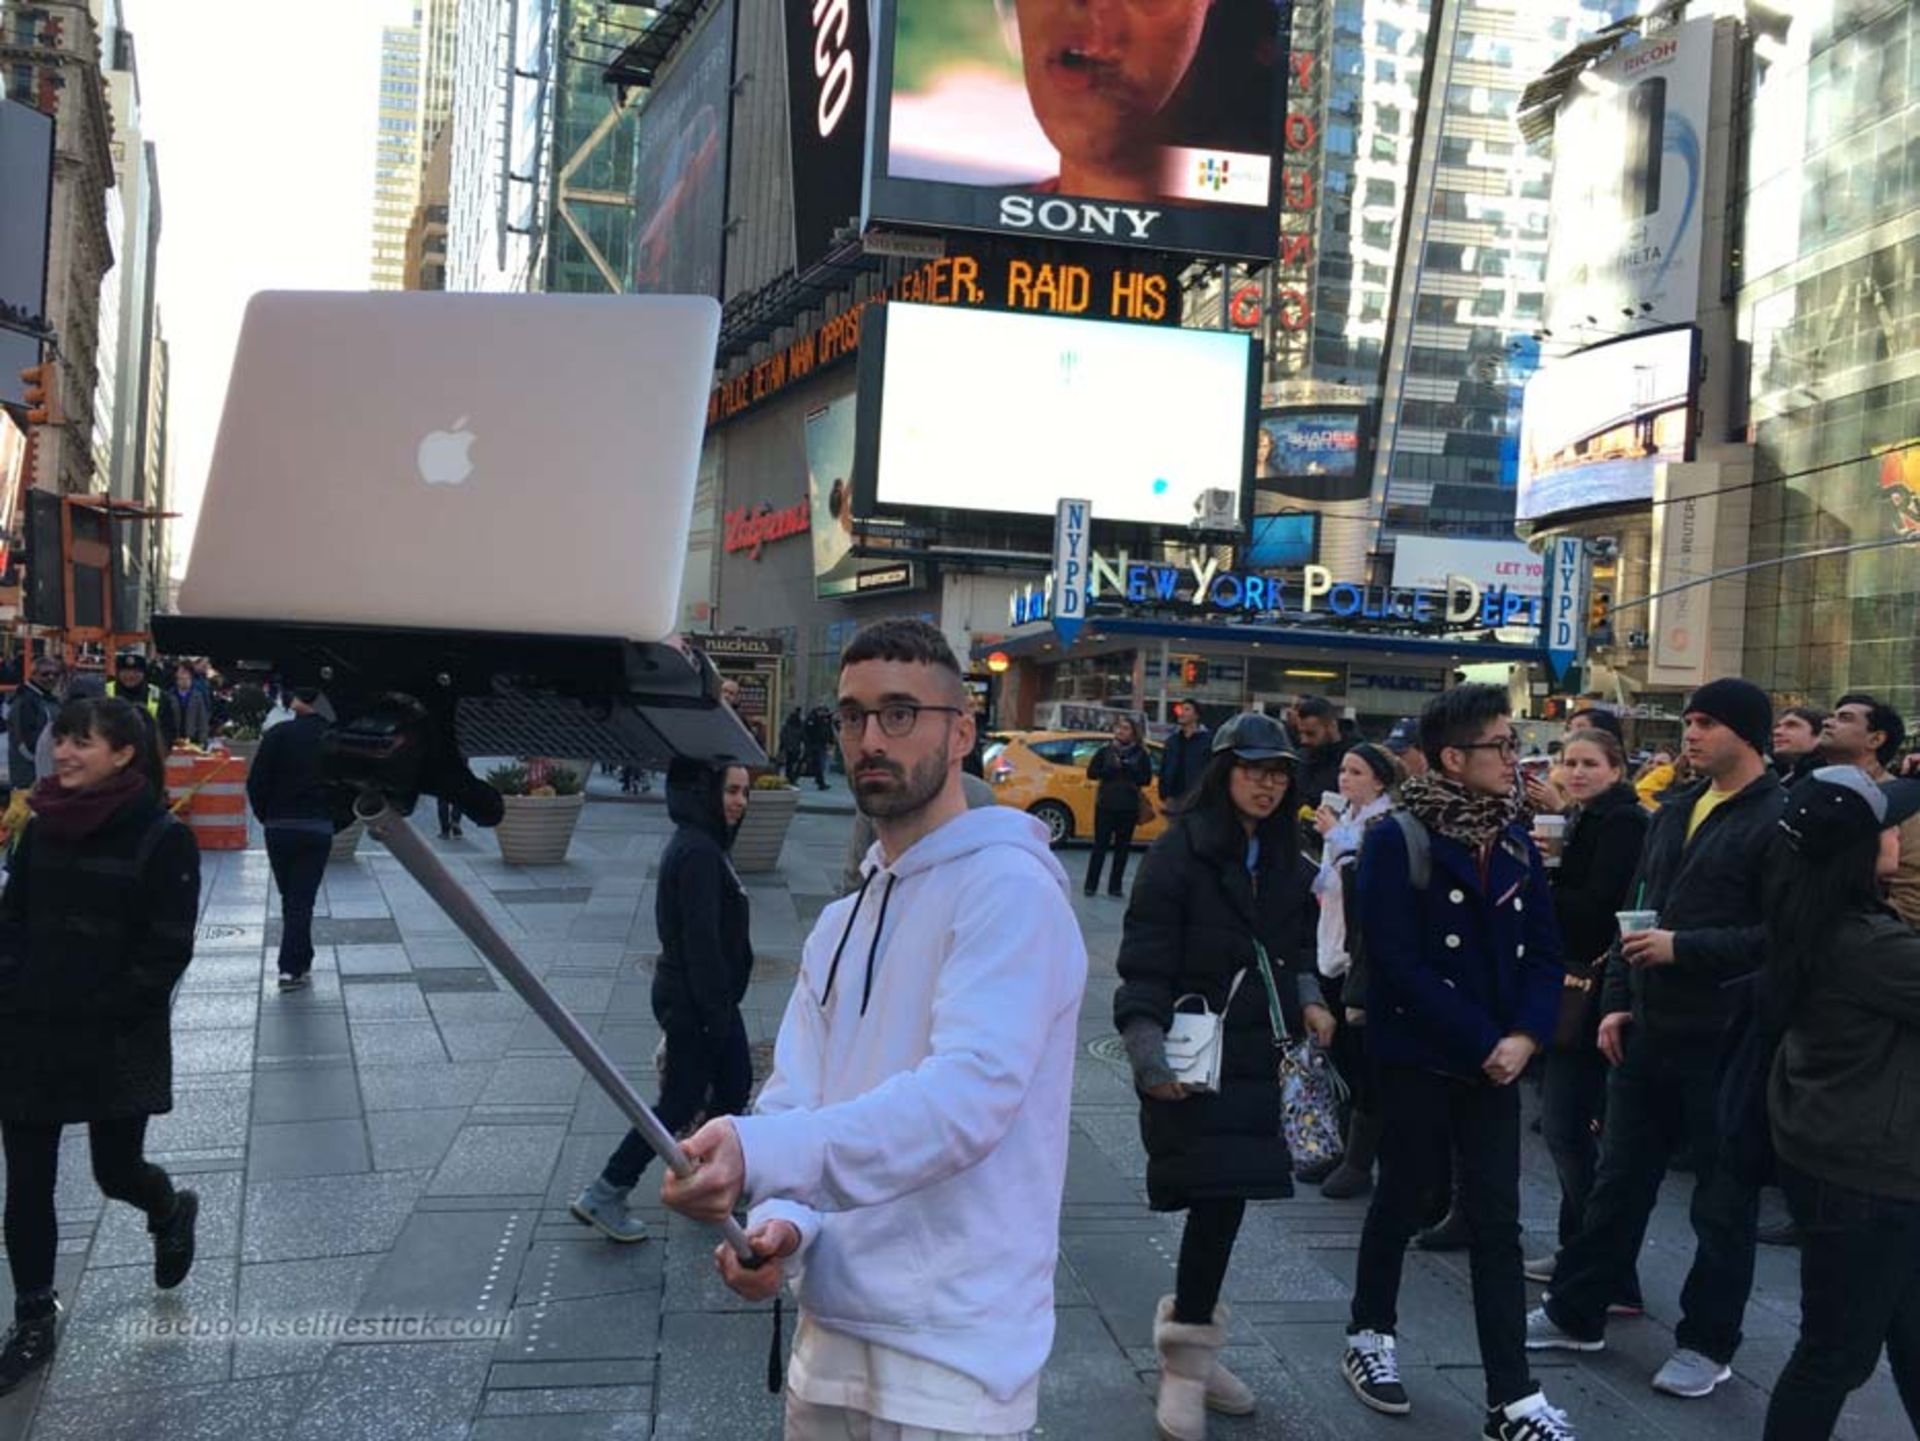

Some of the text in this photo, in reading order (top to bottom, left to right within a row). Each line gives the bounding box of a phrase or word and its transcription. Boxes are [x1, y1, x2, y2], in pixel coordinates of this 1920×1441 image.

[813, 0, 852, 137] CO
[1623, 41, 1677, 72] RICOH
[1000, 195, 1160, 239] SONY
[789, 333, 815, 380] MAN
[1008, 260, 1091, 313] RAID
[1111, 270, 1168, 321] HIS
[1064, 504, 1084, 614] NYPD
[1091, 550, 1179, 600] NEW
[1190, 557, 1286, 614] YORK
[1303, 564, 1432, 622] POLICE
[1495, 562, 1521, 576] LET
[1556, 540, 1578, 646] NYPD
[705, 638, 769, 652] nuchas
